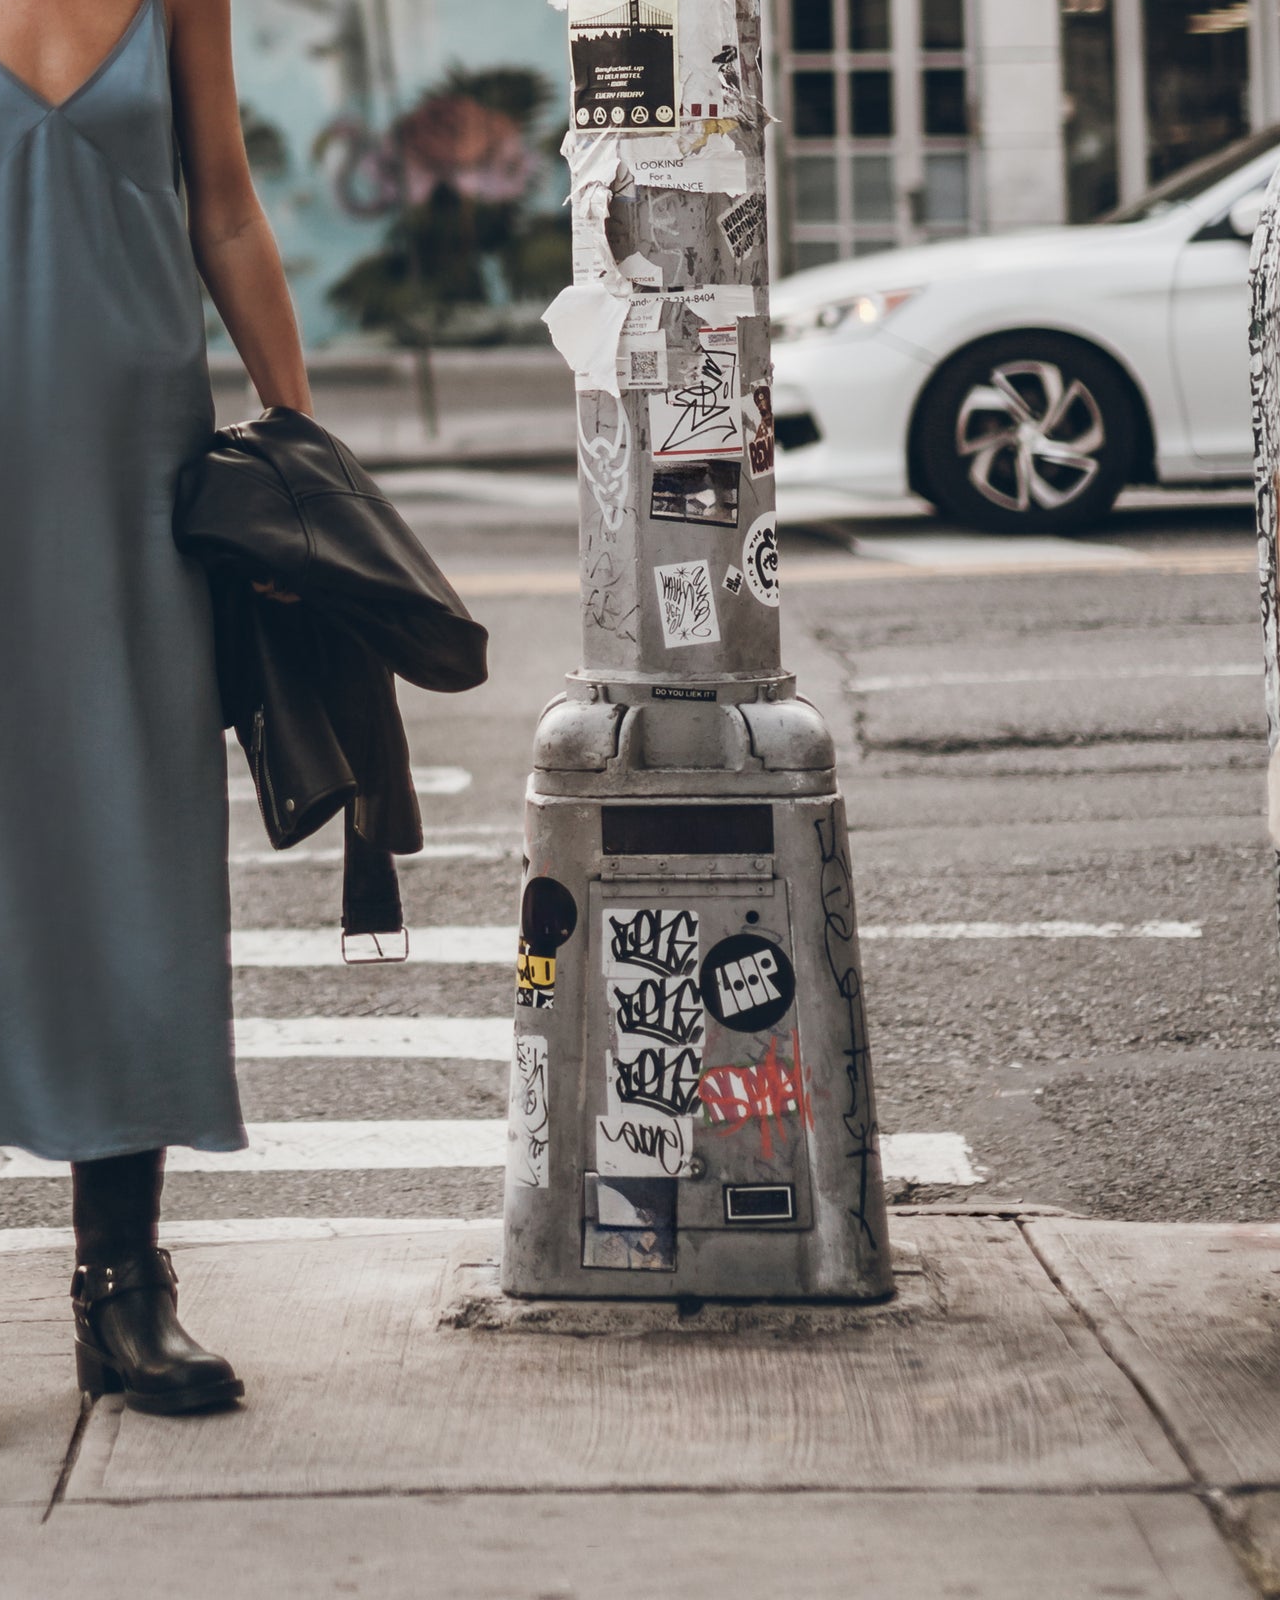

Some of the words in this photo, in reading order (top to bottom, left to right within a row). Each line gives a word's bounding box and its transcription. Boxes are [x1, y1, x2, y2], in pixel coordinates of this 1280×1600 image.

[595, 92, 616, 100] EVERY
[616, 91, 644, 99] FRIDAY
[635, 160, 684, 170] LOOKING
[655, 688, 667, 696] DO
[668, 689, 685, 697] YOU
[686, 689, 702, 698] LIEK
[715, 949, 782, 1018] LOOP
